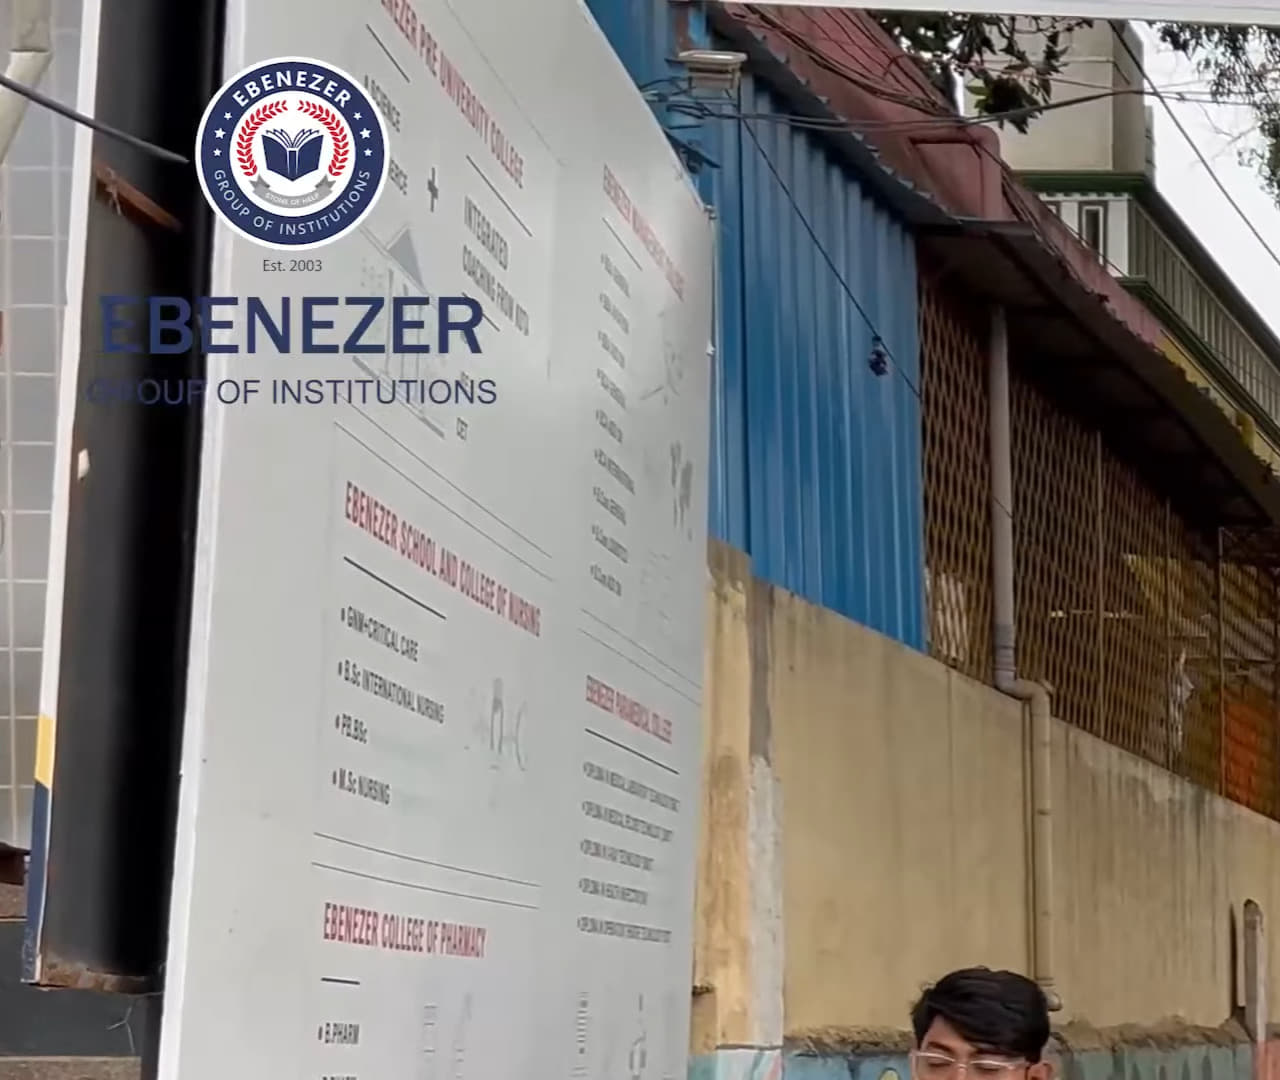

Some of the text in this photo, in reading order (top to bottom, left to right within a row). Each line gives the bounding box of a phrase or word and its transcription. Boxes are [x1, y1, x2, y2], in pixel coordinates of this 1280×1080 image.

[345, 480, 399, 550] EBENEZER
[400, 519, 437, 576] SCHOOL
[438, 547, 458, 588] AND
[459, 560, 495, 612] COLLEGE
[324, 902, 487, 959] EBENEZER COLLEGE OF PHARMACY
[325, 1022, 360, 1045] B.PHARM
